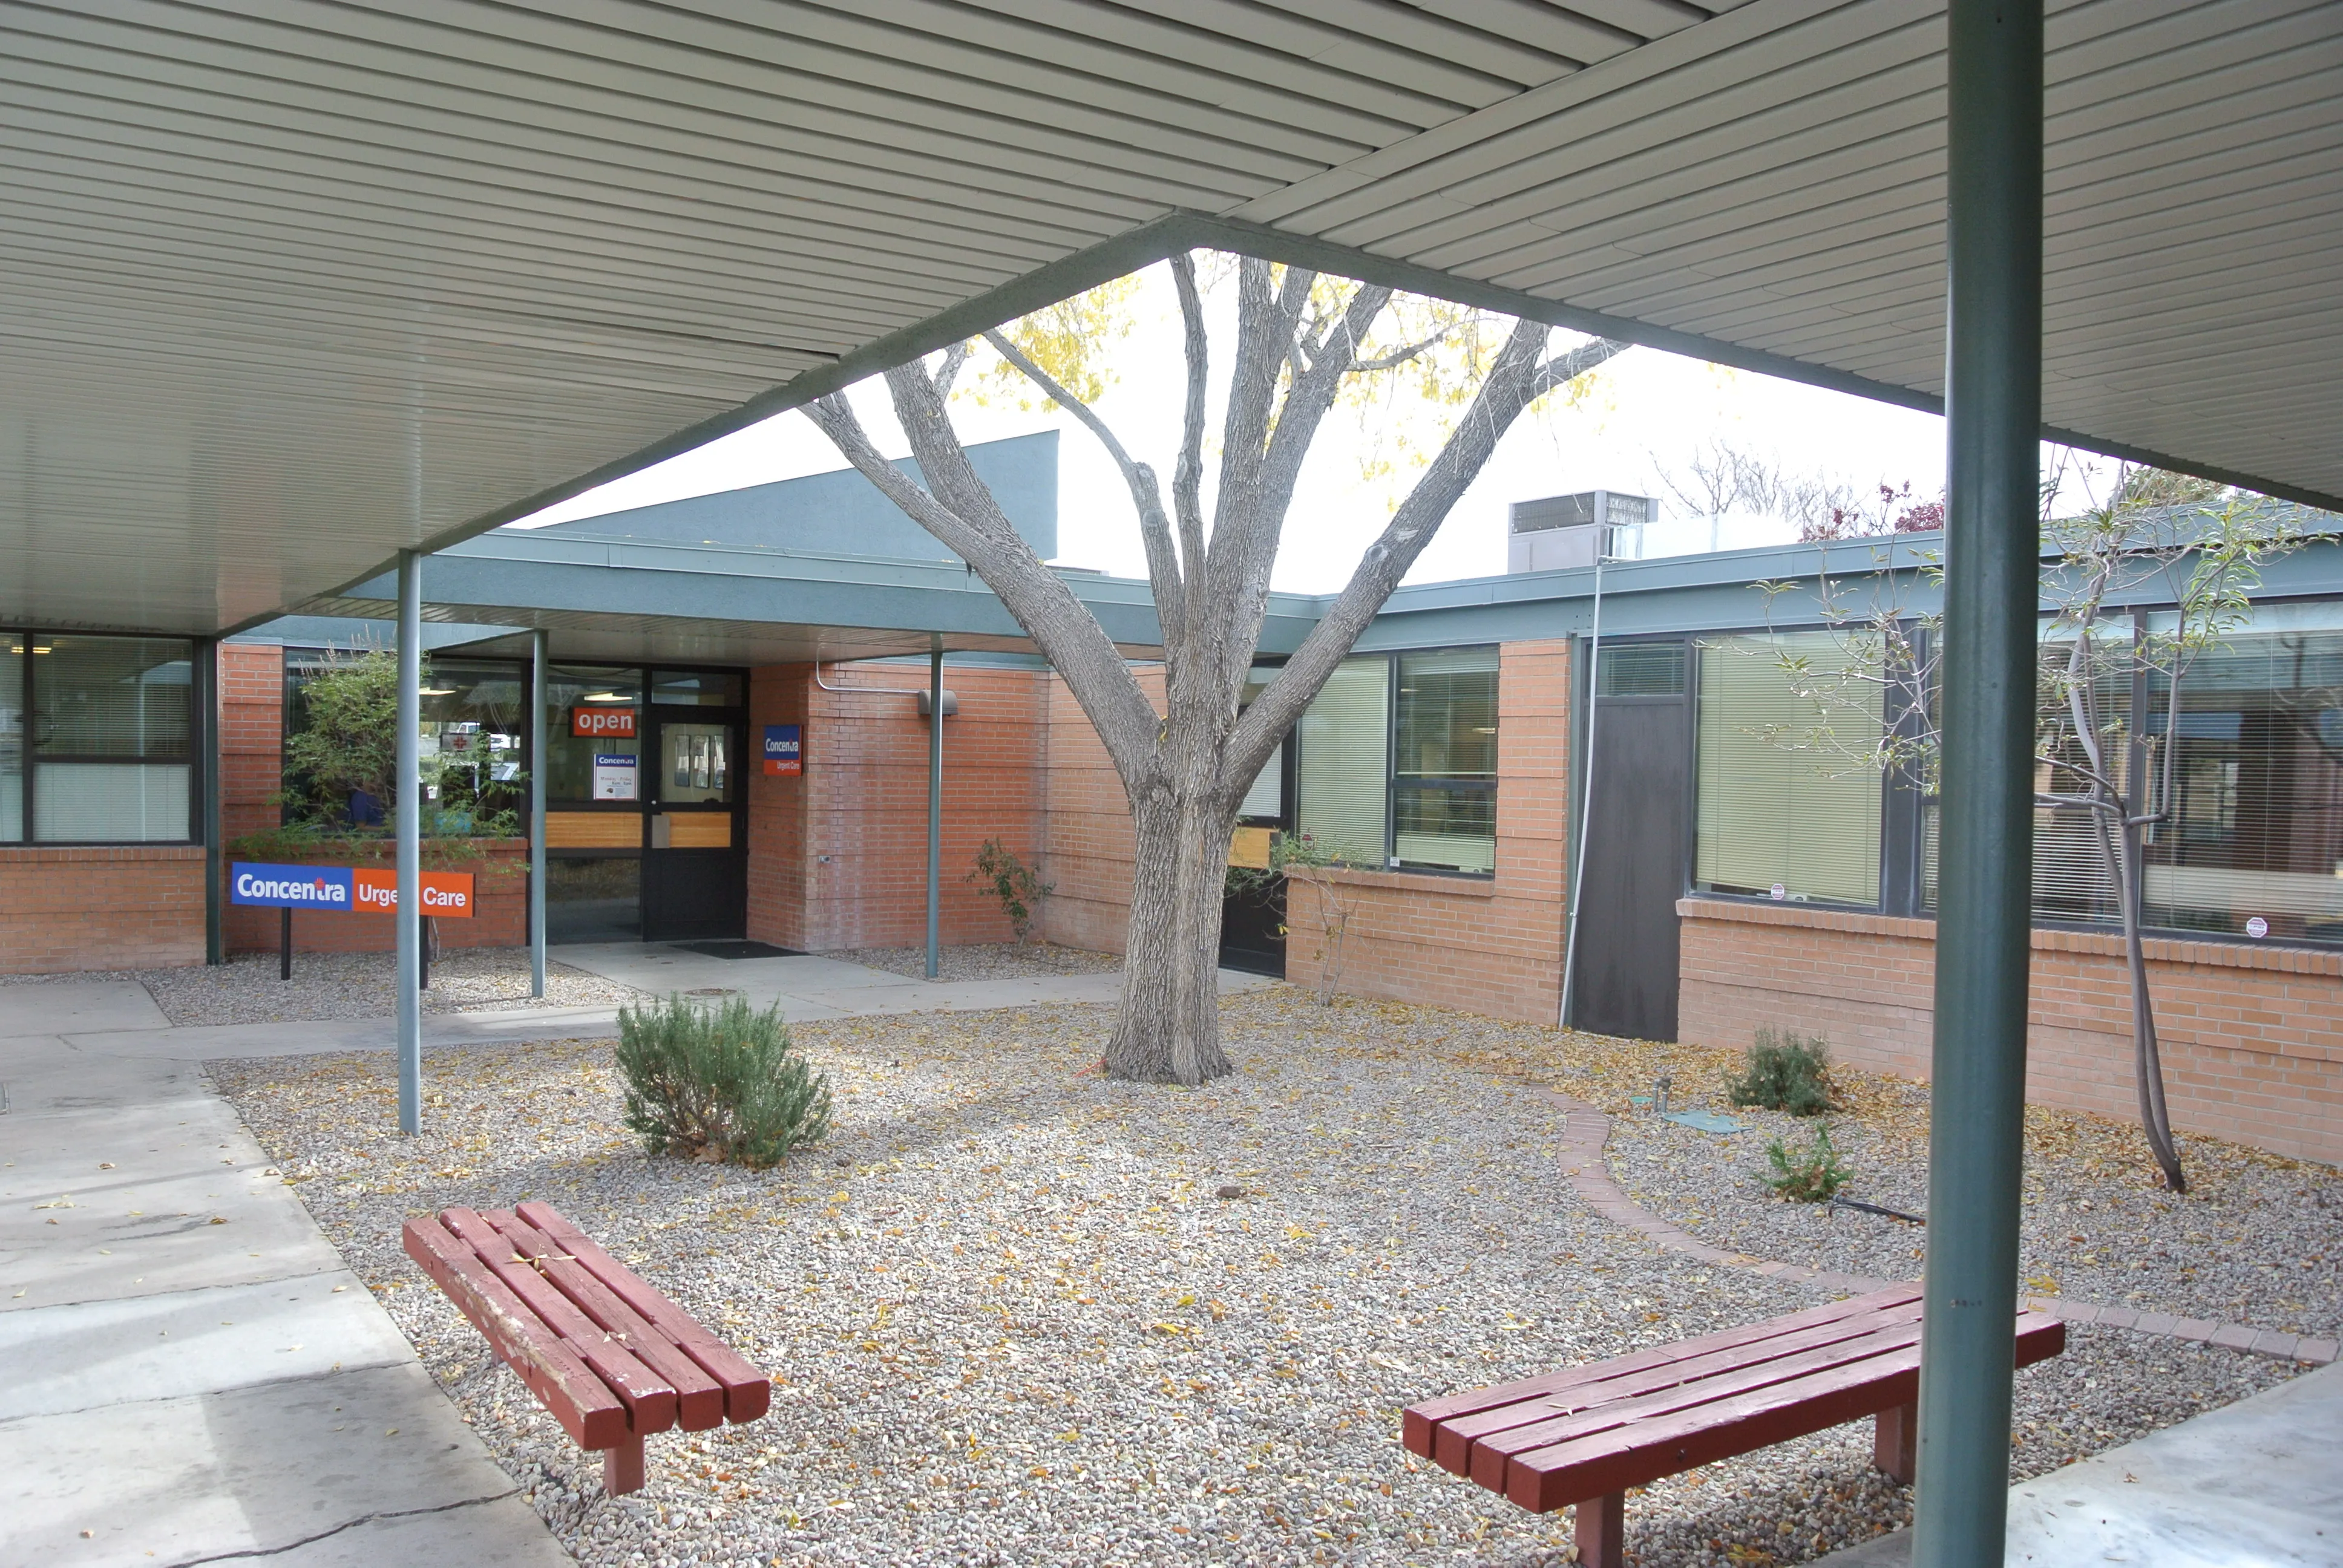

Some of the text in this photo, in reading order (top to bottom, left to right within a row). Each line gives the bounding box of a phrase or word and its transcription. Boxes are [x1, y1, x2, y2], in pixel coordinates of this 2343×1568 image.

[579, 714, 632, 733] open
[765, 738, 798, 751] Concentra
[238, 874, 466, 907] Concentra Urge Care
